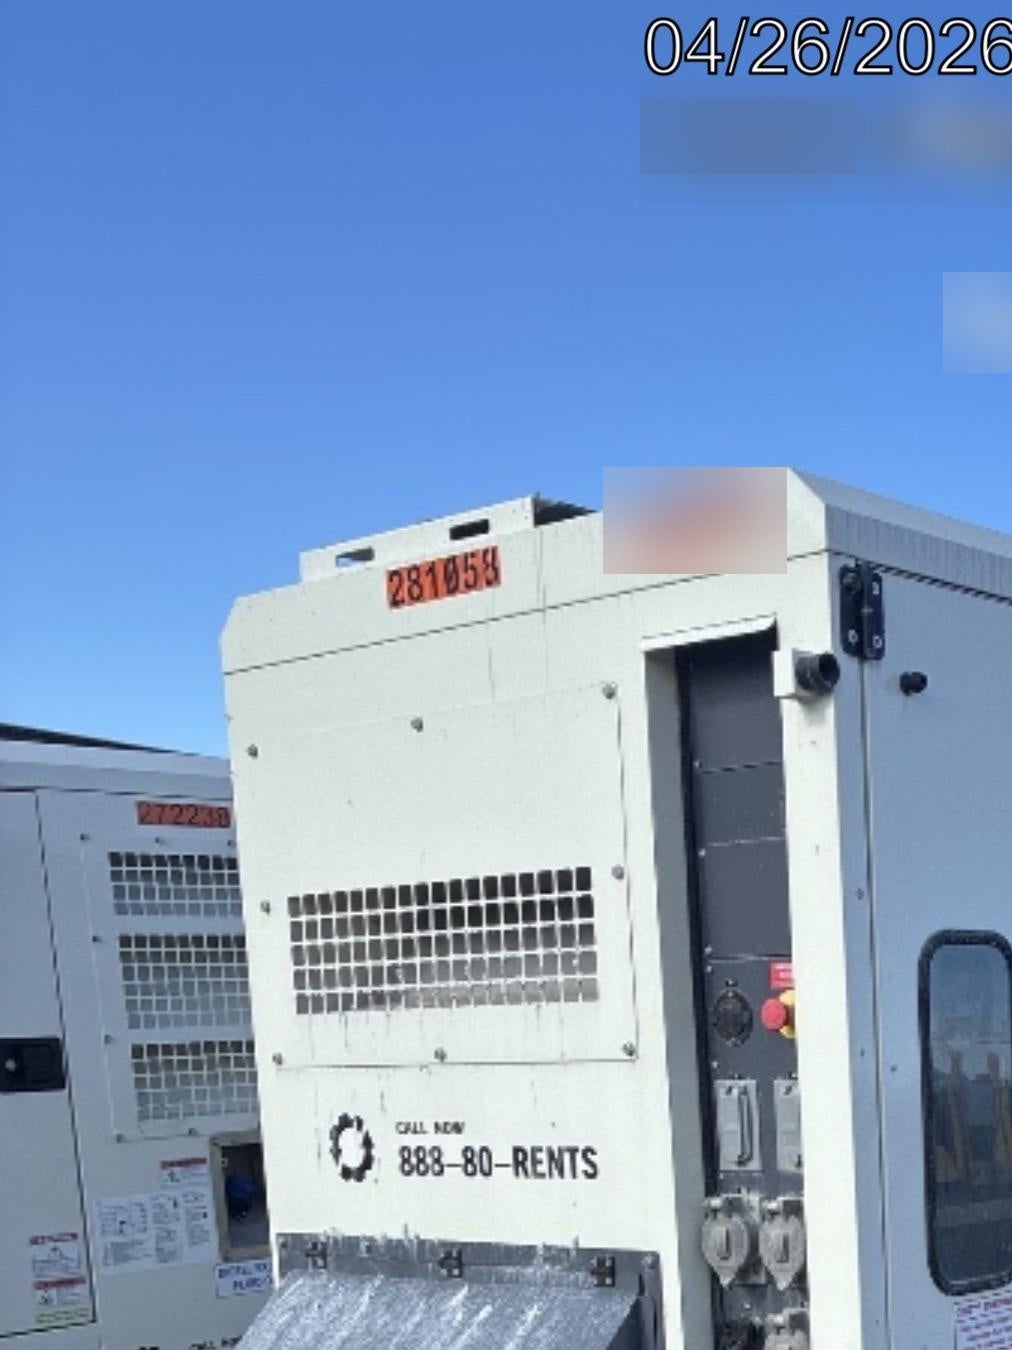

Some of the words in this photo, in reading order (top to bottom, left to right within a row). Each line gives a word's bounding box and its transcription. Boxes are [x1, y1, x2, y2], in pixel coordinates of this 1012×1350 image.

[396, 1121, 427, 1135] CALL
[434, 1121, 465, 1135] NOW
[400, 1145, 598, 1179] 888-80-RENTS
